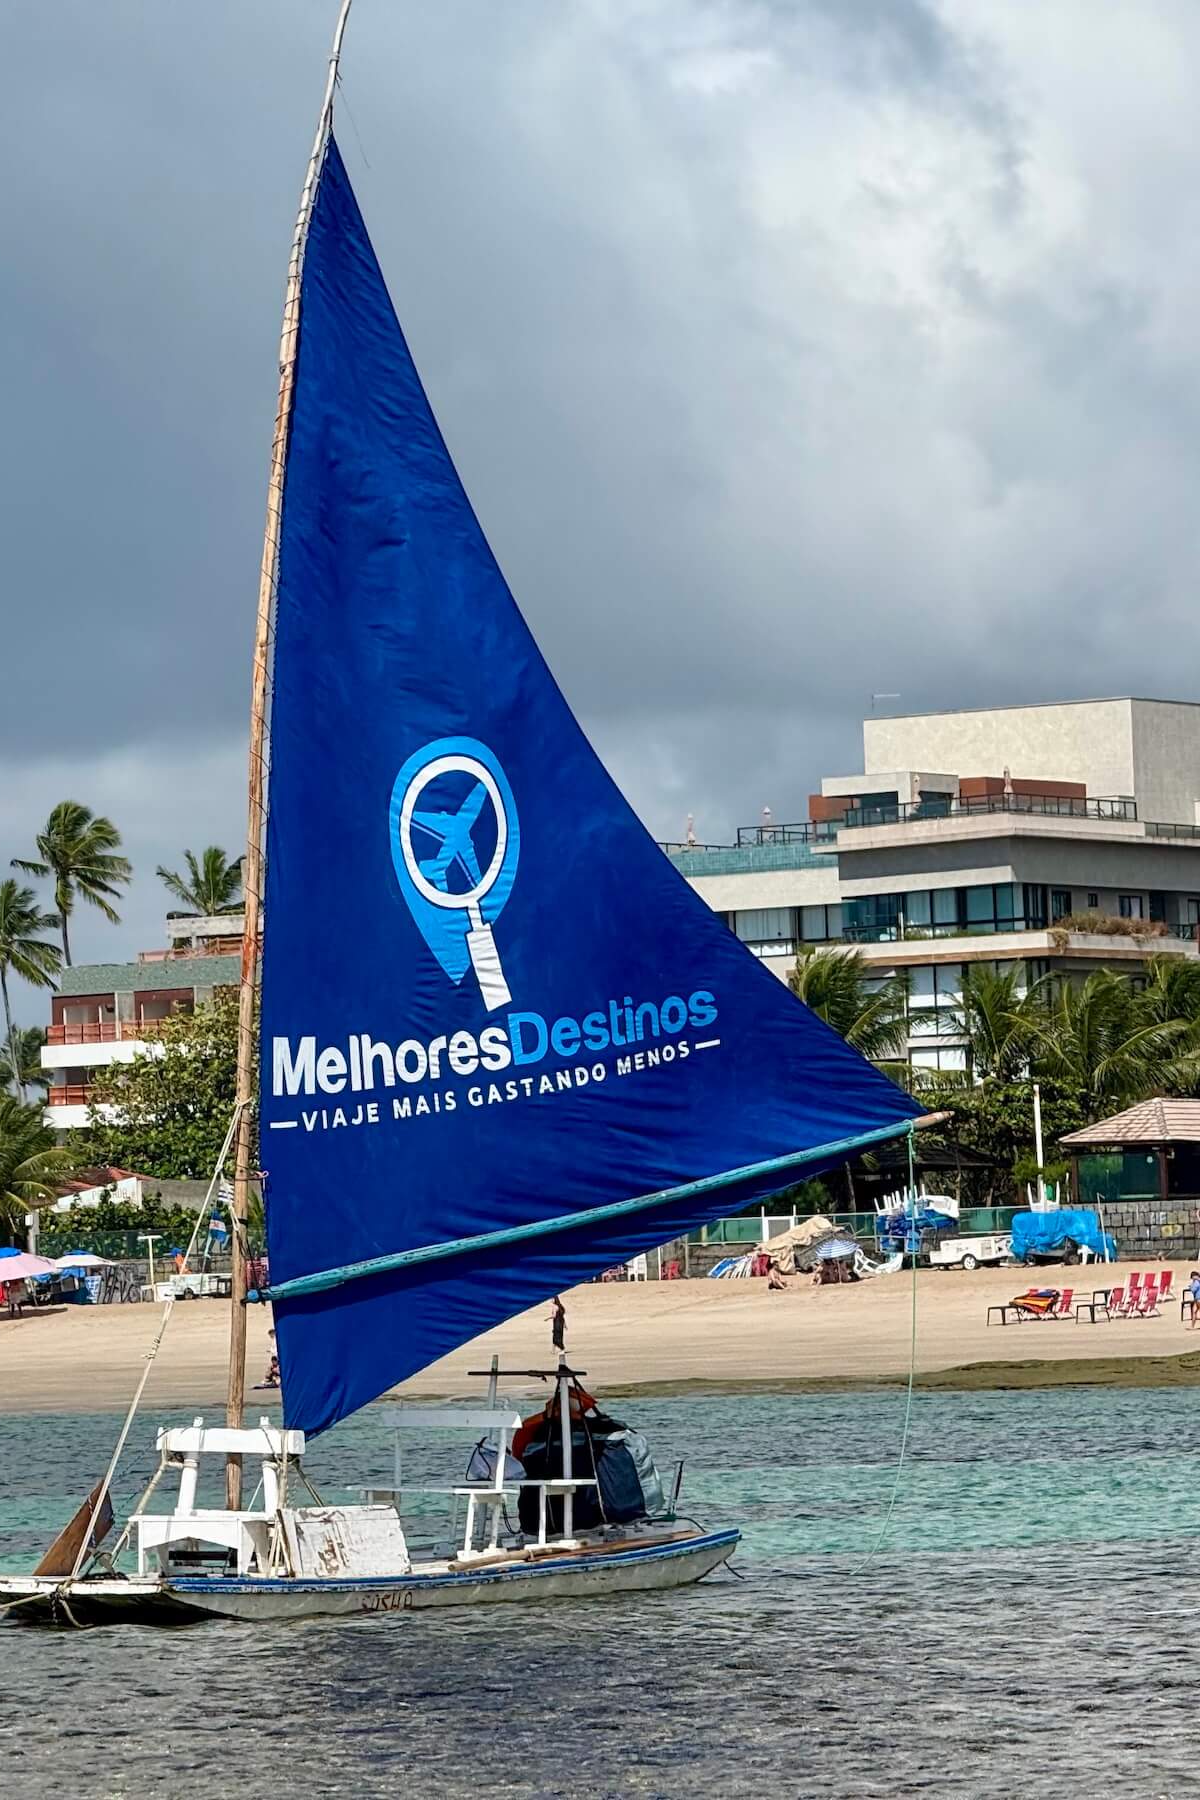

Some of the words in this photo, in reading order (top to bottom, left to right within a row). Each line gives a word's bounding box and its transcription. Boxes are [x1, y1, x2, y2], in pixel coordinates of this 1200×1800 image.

[301, 1102, 380, 1132] VIAJE
[392, 1090, 457, 1120] MAIS
[467, 1062, 606, 1107] GASTANDO
[616, 1040, 690, 1076] MENOS
